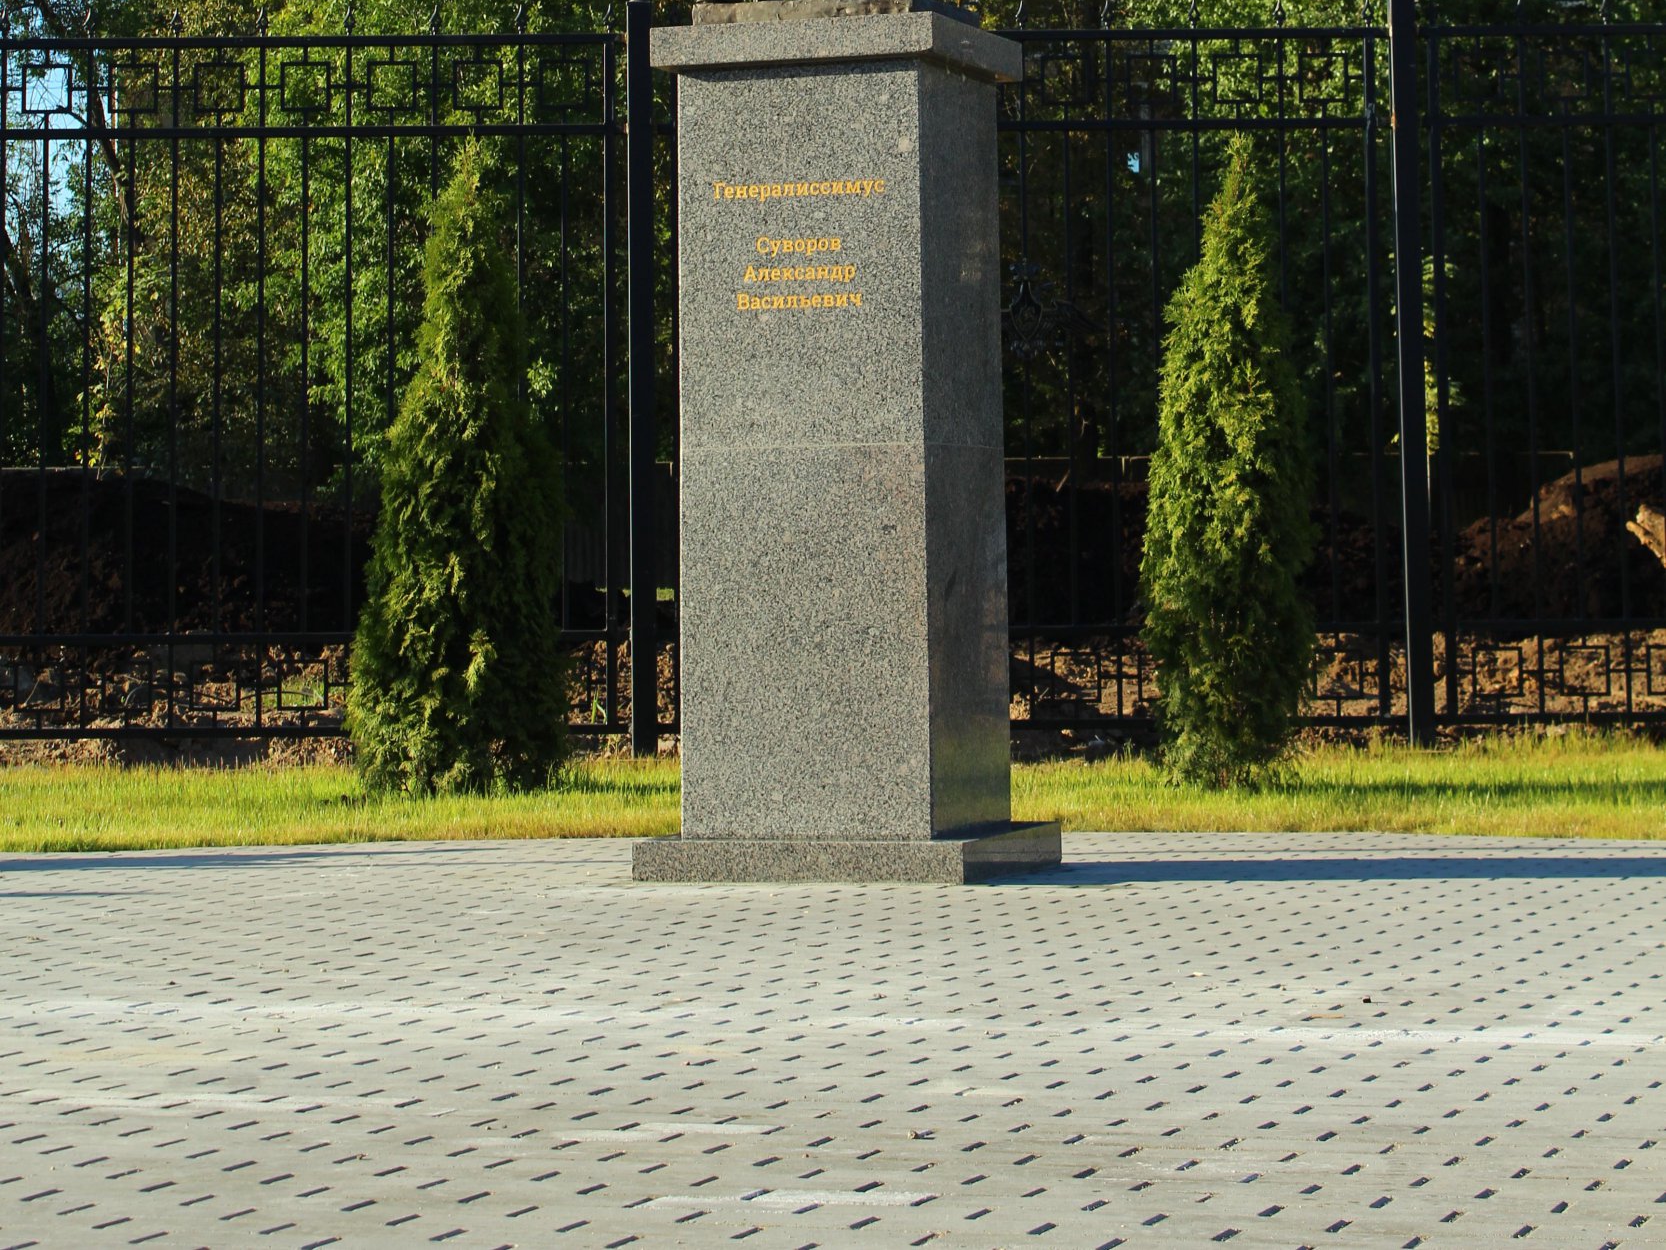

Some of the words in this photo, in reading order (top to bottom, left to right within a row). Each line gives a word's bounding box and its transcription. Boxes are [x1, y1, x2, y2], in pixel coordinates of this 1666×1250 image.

[713, 179, 885, 202] Генералиссимус
[756, 236, 841, 257] Суворов
[743, 264, 856, 282] Александр
[736, 292, 862, 310] Васильевич
